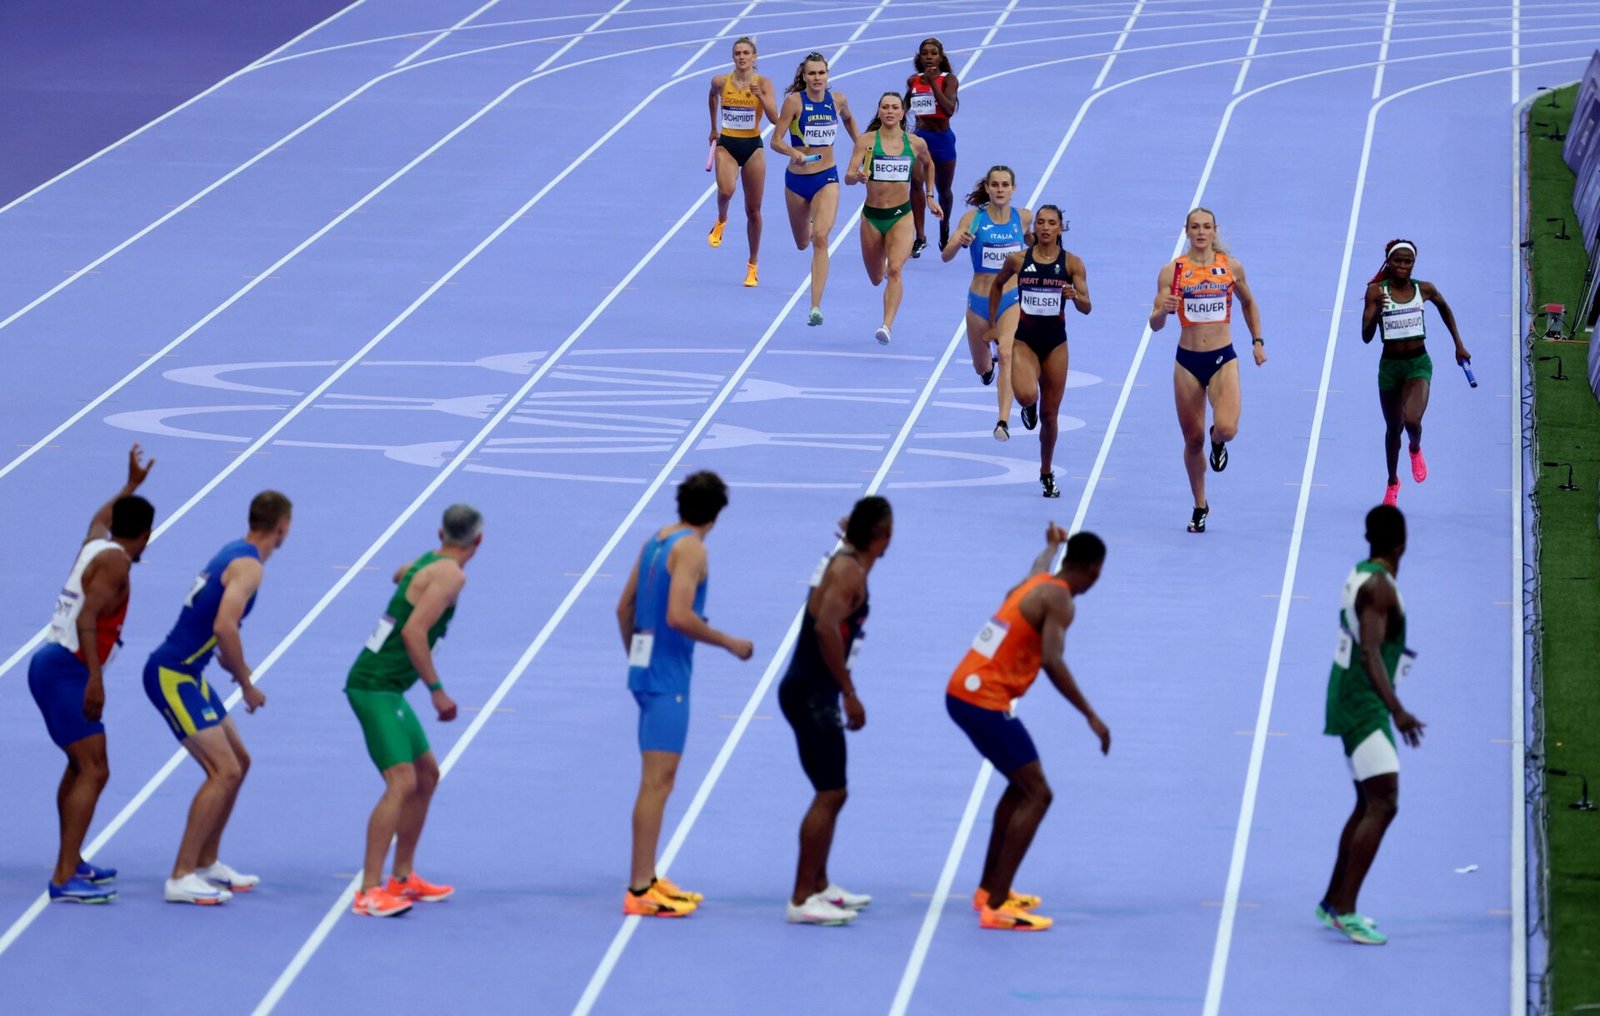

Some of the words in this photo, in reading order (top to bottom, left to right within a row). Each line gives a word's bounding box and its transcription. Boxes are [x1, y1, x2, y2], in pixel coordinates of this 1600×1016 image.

[723, 113, 755, 122] SCHMIDT
[875, 163, 909, 173] BECKER
[983, 251, 1012, 261] POLIN
[1023, 295, 1060, 307] NIELSEN
[1187, 301, 1225, 313] KLAVER
